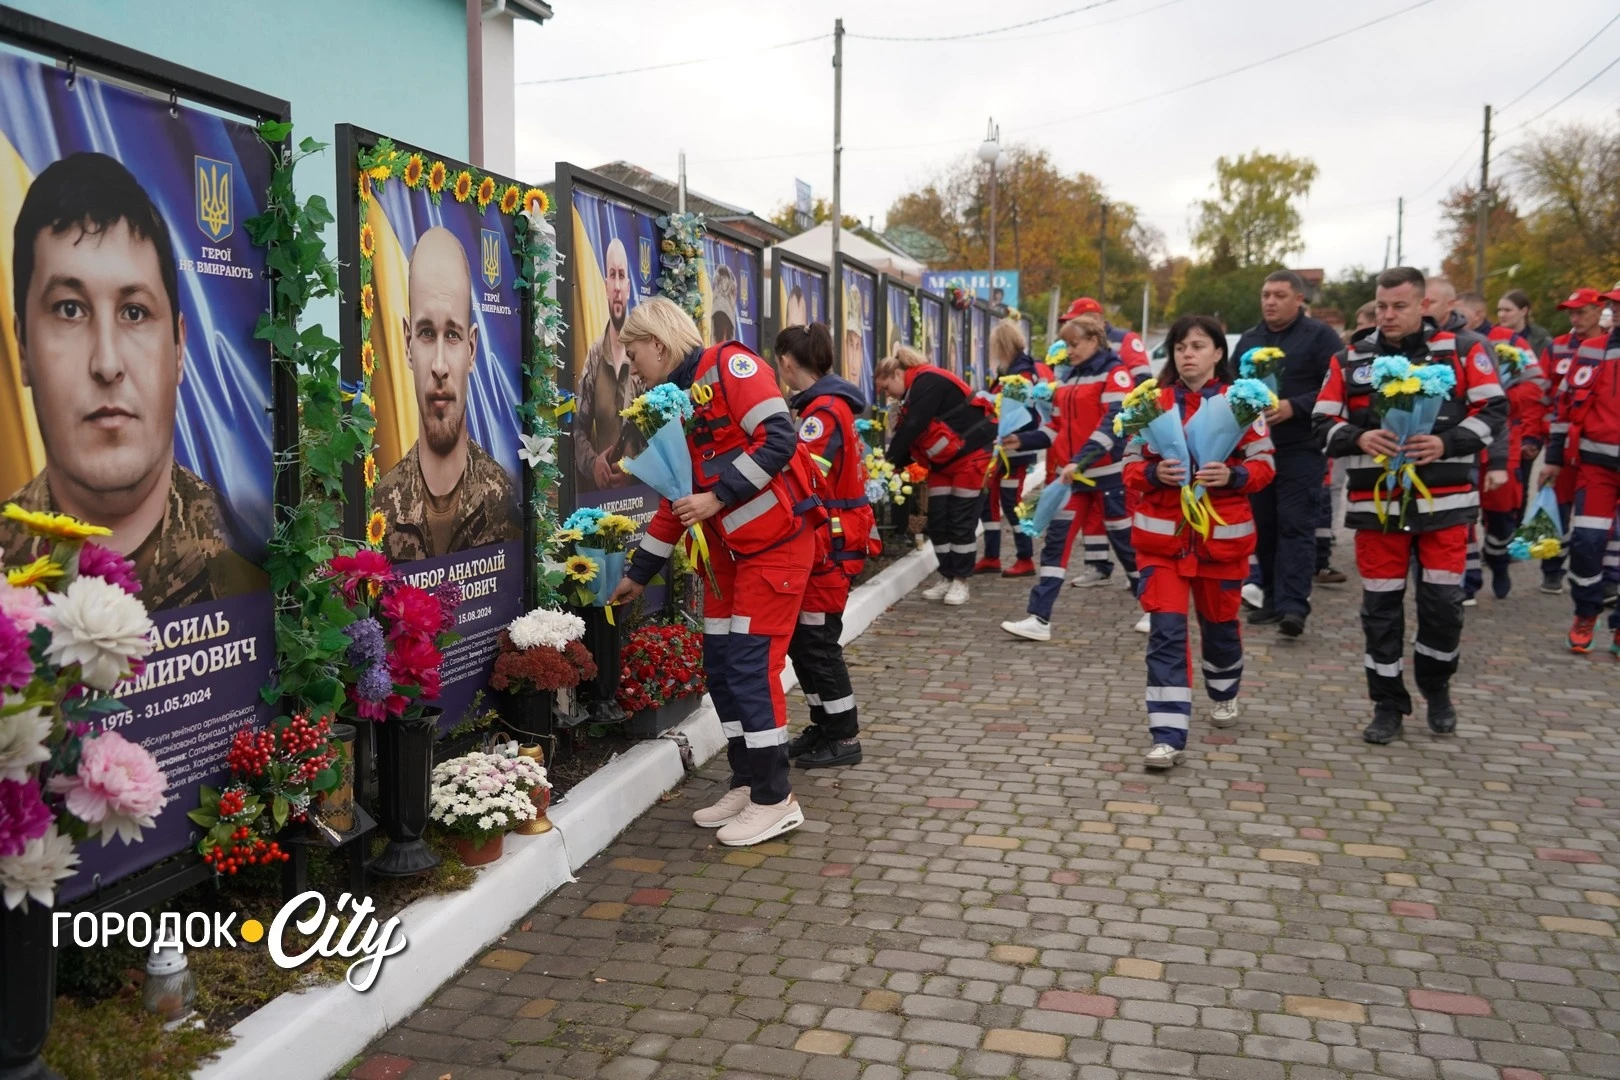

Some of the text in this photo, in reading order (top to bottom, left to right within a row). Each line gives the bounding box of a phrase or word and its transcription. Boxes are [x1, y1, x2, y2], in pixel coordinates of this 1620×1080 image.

[201, 246, 232, 262] ГЕРОЇ
[179, 258, 254, 279] НЕ ВМИРАЮТЬ
[483, 292, 500, 303] ГЕРОЇ
[481, 303, 512, 315] ВМИРАЮТЬ
[448, 549, 506, 582] АНАТОЛІЙ
[458, 606, 492, 625] 15.08.2024
[149, 611, 230, 652] АСИЛЬ
[113, 636, 257, 699] ИМИРОВИЧ
[144, 687, 212, 719] 31.05.2024
[171, 722, 202, 740] зенітного
[202, 705, 255, 728] артилерійського
[157, 752, 188, 768] авчання:
